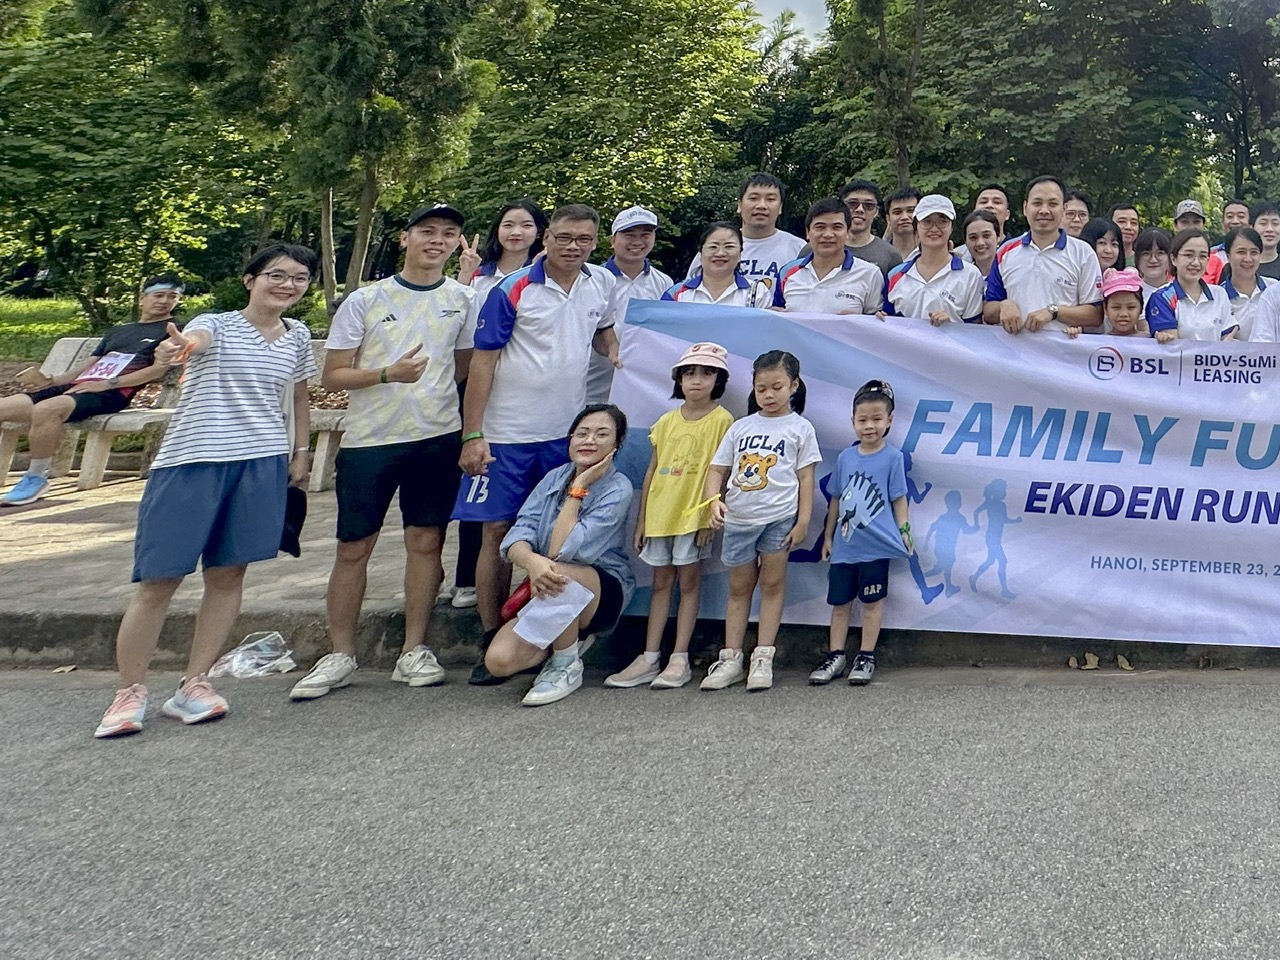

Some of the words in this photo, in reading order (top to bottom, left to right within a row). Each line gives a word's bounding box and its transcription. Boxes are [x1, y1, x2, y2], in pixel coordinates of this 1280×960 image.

[738, 259, 779, 278] CLA
[1130, 357, 1169, 375] BSL
[1194, 354, 1277, 369] BIDV-SuMi
[1194, 368, 1262, 385] LEASING
[902, 399, 1180, 466] FAMILY
[738, 435, 785, 456] UCLA
[466, 474, 490, 504] 13
[1024, 481, 1184, 521] EKIDEN
[1090, 556, 1147, 573] HANOI,
[1152, 558, 1242, 575] SEPTEMBER
[1246, 563, 1268, 577] 23,
[864, 584, 882, 596] GAP
